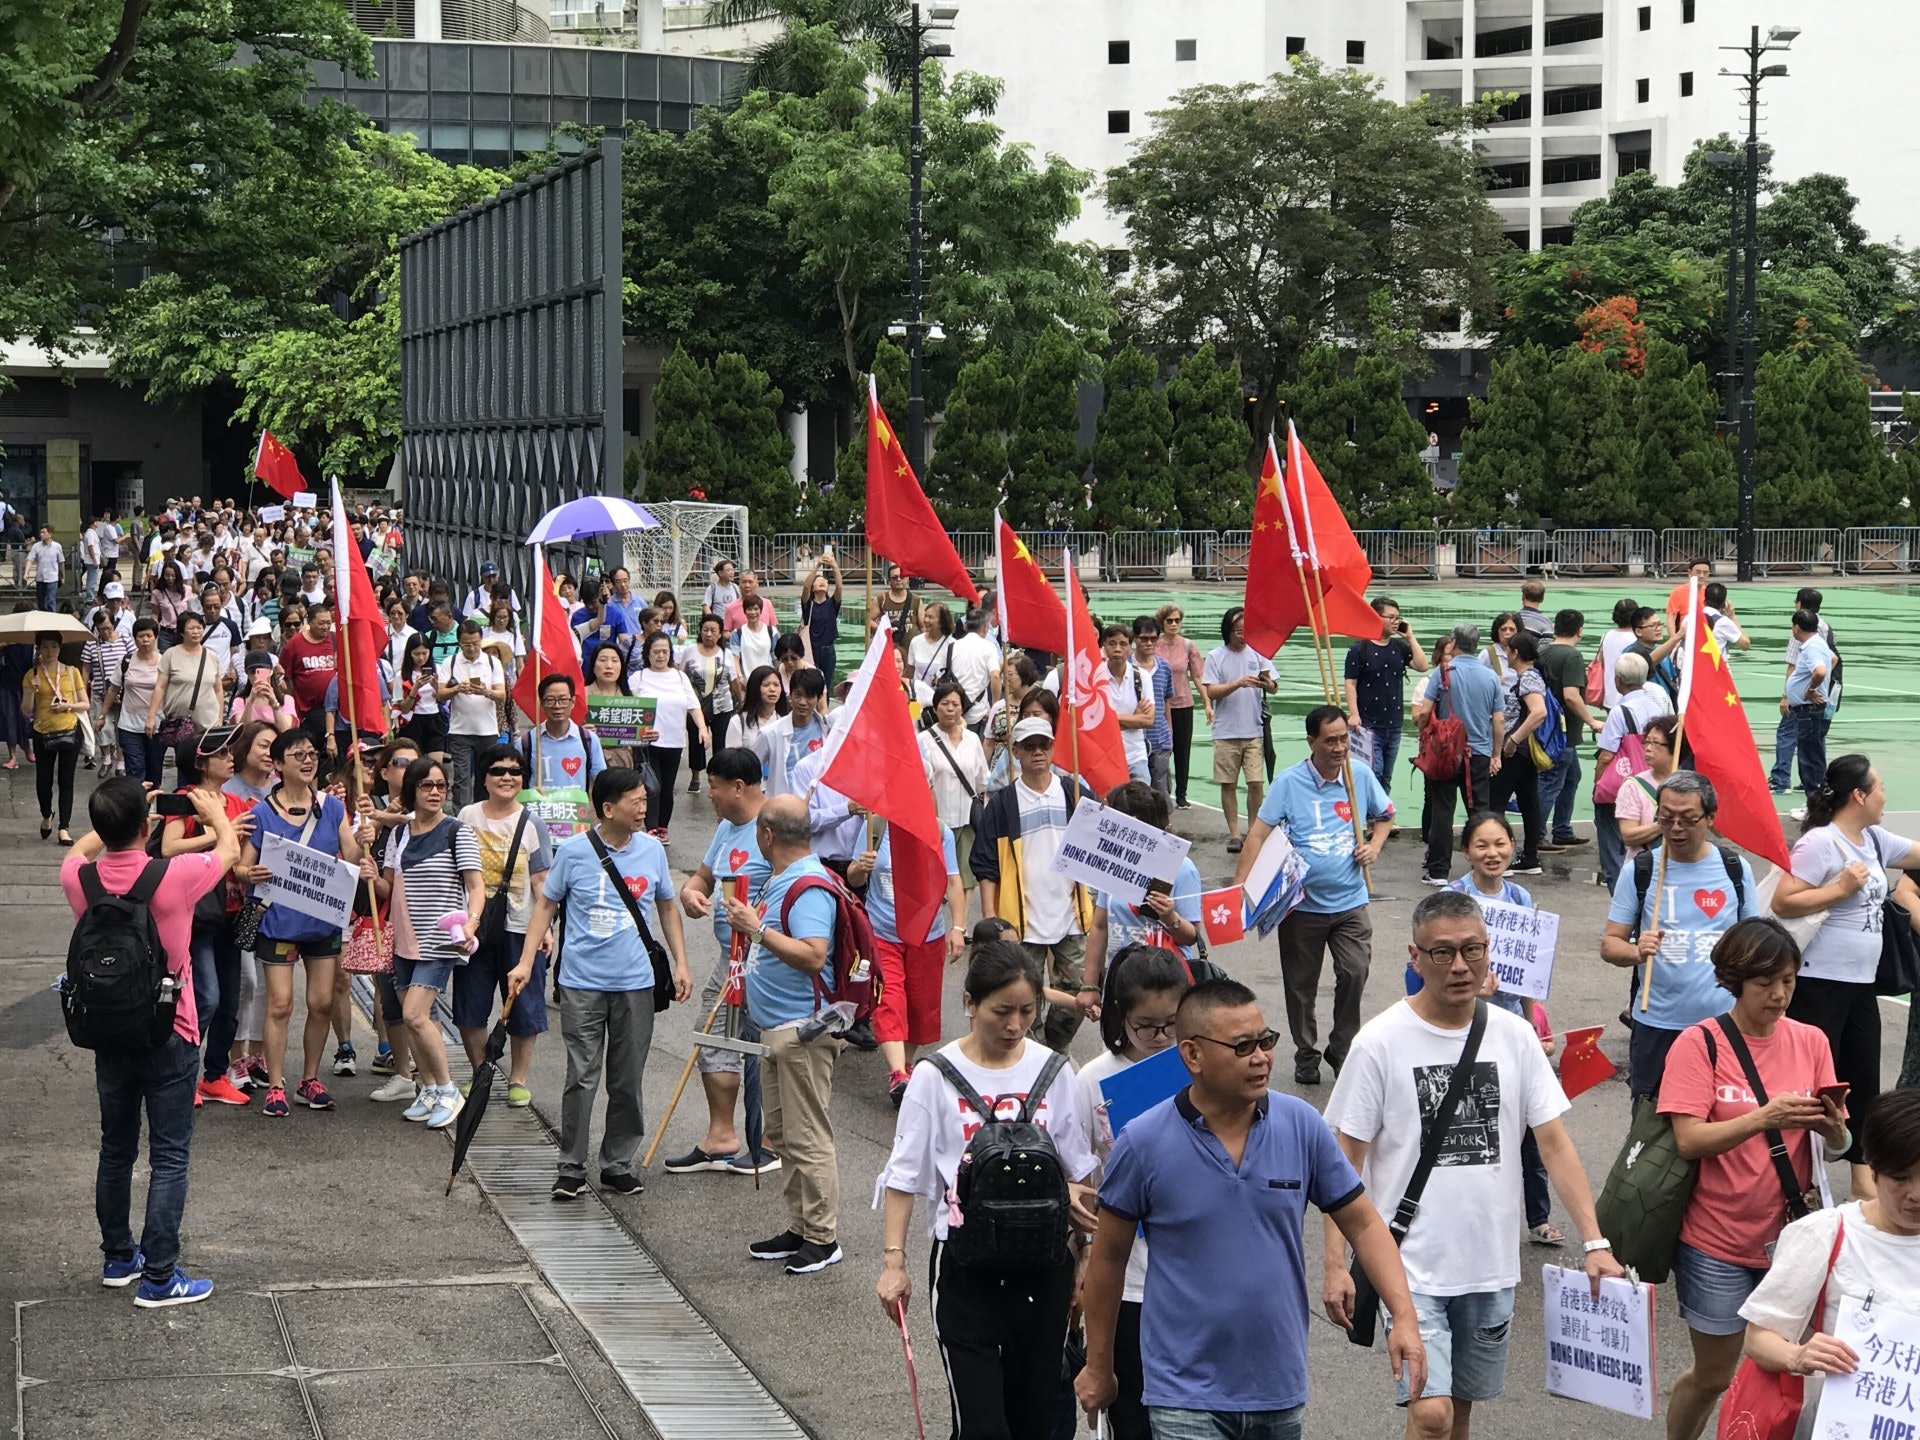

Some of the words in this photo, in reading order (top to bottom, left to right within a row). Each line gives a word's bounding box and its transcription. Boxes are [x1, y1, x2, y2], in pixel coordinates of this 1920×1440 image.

[599, 707, 644, 724] 希望明天
[542, 756, 553, 782] I
[566, 763, 578, 771] HK
[526, 801, 578, 820] 希望明天
[1311, 800, 1326, 830] I
[1096, 818, 1160, 853] 感謝香港警察
[1308, 830, 1354, 857] 警察
[285, 850, 336, 878] 感謝香港警察
[1063, 842, 1085, 864] HONG
[1085, 854, 1109, 873] KONG
[1108, 862, 1138, 884] POLICE
[1135, 872, 1152, 891] FOR
[1097, 837, 1127, 859] THANK
[1124, 847, 1142, 866] YOU
[289, 866, 311, 884] THANK
[312, 877, 326, 889] YOU
[594, 872, 608, 906] I
[628, 883, 641, 893] HK
[283, 880, 301, 895] KONG
[302, 886, 326, 905] POLICE
[325, 896, 347, 913] FORCE
[1663, 886, 1680, 924] I
[1701, 897, 1718, 908] HK
[1480, 904, 1541, 938] 建香港未來
[1488, 933, 1538, 963] 大家做起
[1496, 961, 1525, 987] PEACE
[1459, 1133, 1486, 1147] YORK
[1561, 1315, 1630, 1354] 請停止一切暴力
[1550, 1340, 1572, 1366] HONG
[1574, 1347, 1596, 1373] KONG
[1597, 1355, 1621, 1380] NEEDS
[1855, 1370, 1915, 1413] 香港人
[1869, 1413, 1916, 1440] HOPE
